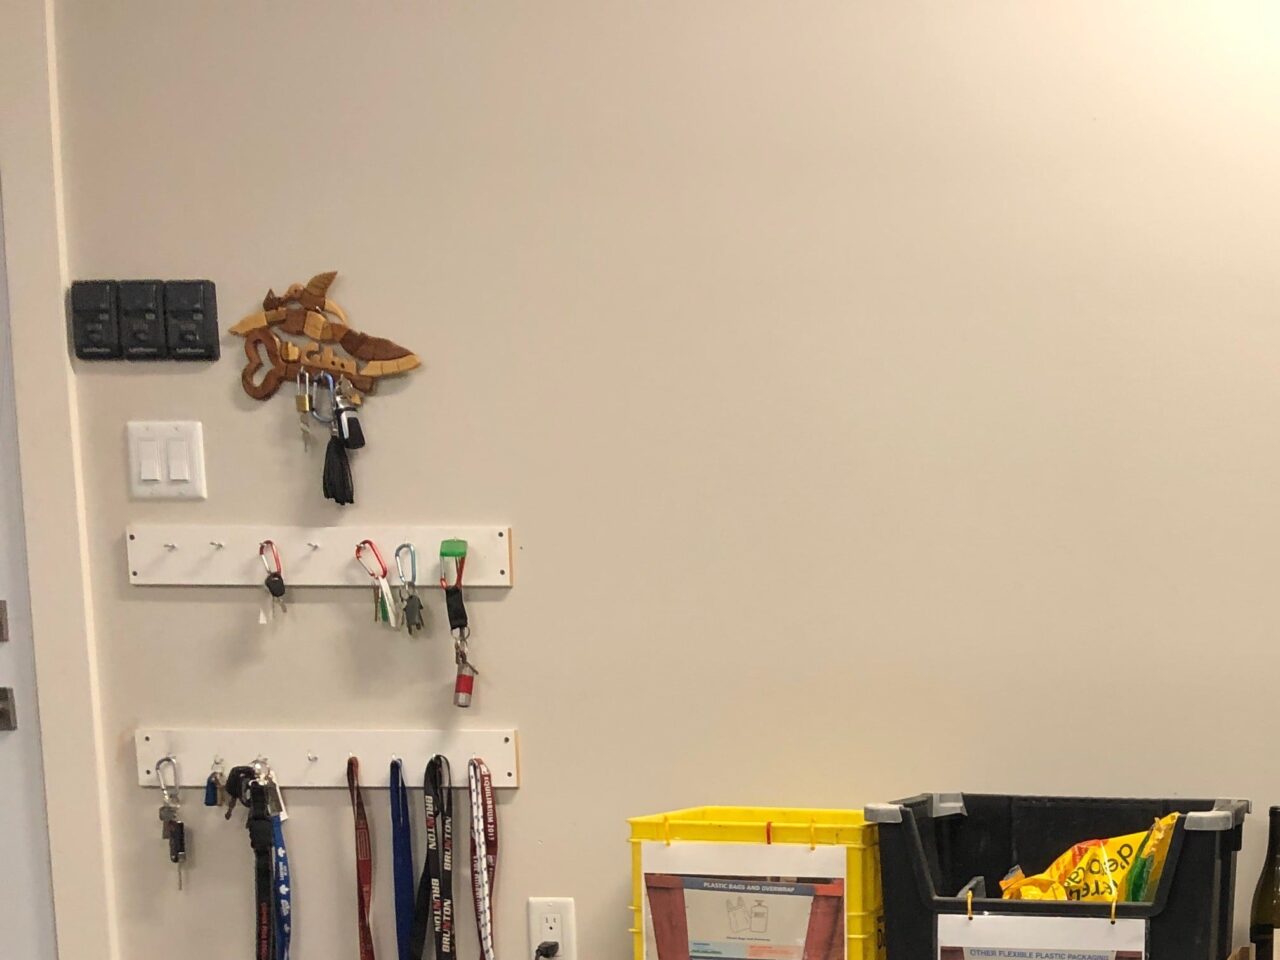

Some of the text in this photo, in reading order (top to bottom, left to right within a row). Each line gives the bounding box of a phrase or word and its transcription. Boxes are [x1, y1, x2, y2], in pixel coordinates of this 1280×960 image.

[425, 796, 436, 850] BRUNTON
[484, 776, 494, 823] EQUILIBRIUM
[443, 816, 452, 871] BRUNTON
[431, 878, 442, 932] BRUNTON
[761, 885, 796, 893] OVERWRAP
[442, 899, 451, 953] BRUNTON
[999, 951, 1034, 959] FLEXIBLE
[1036, 952, 1066, 960] PLASTIC
